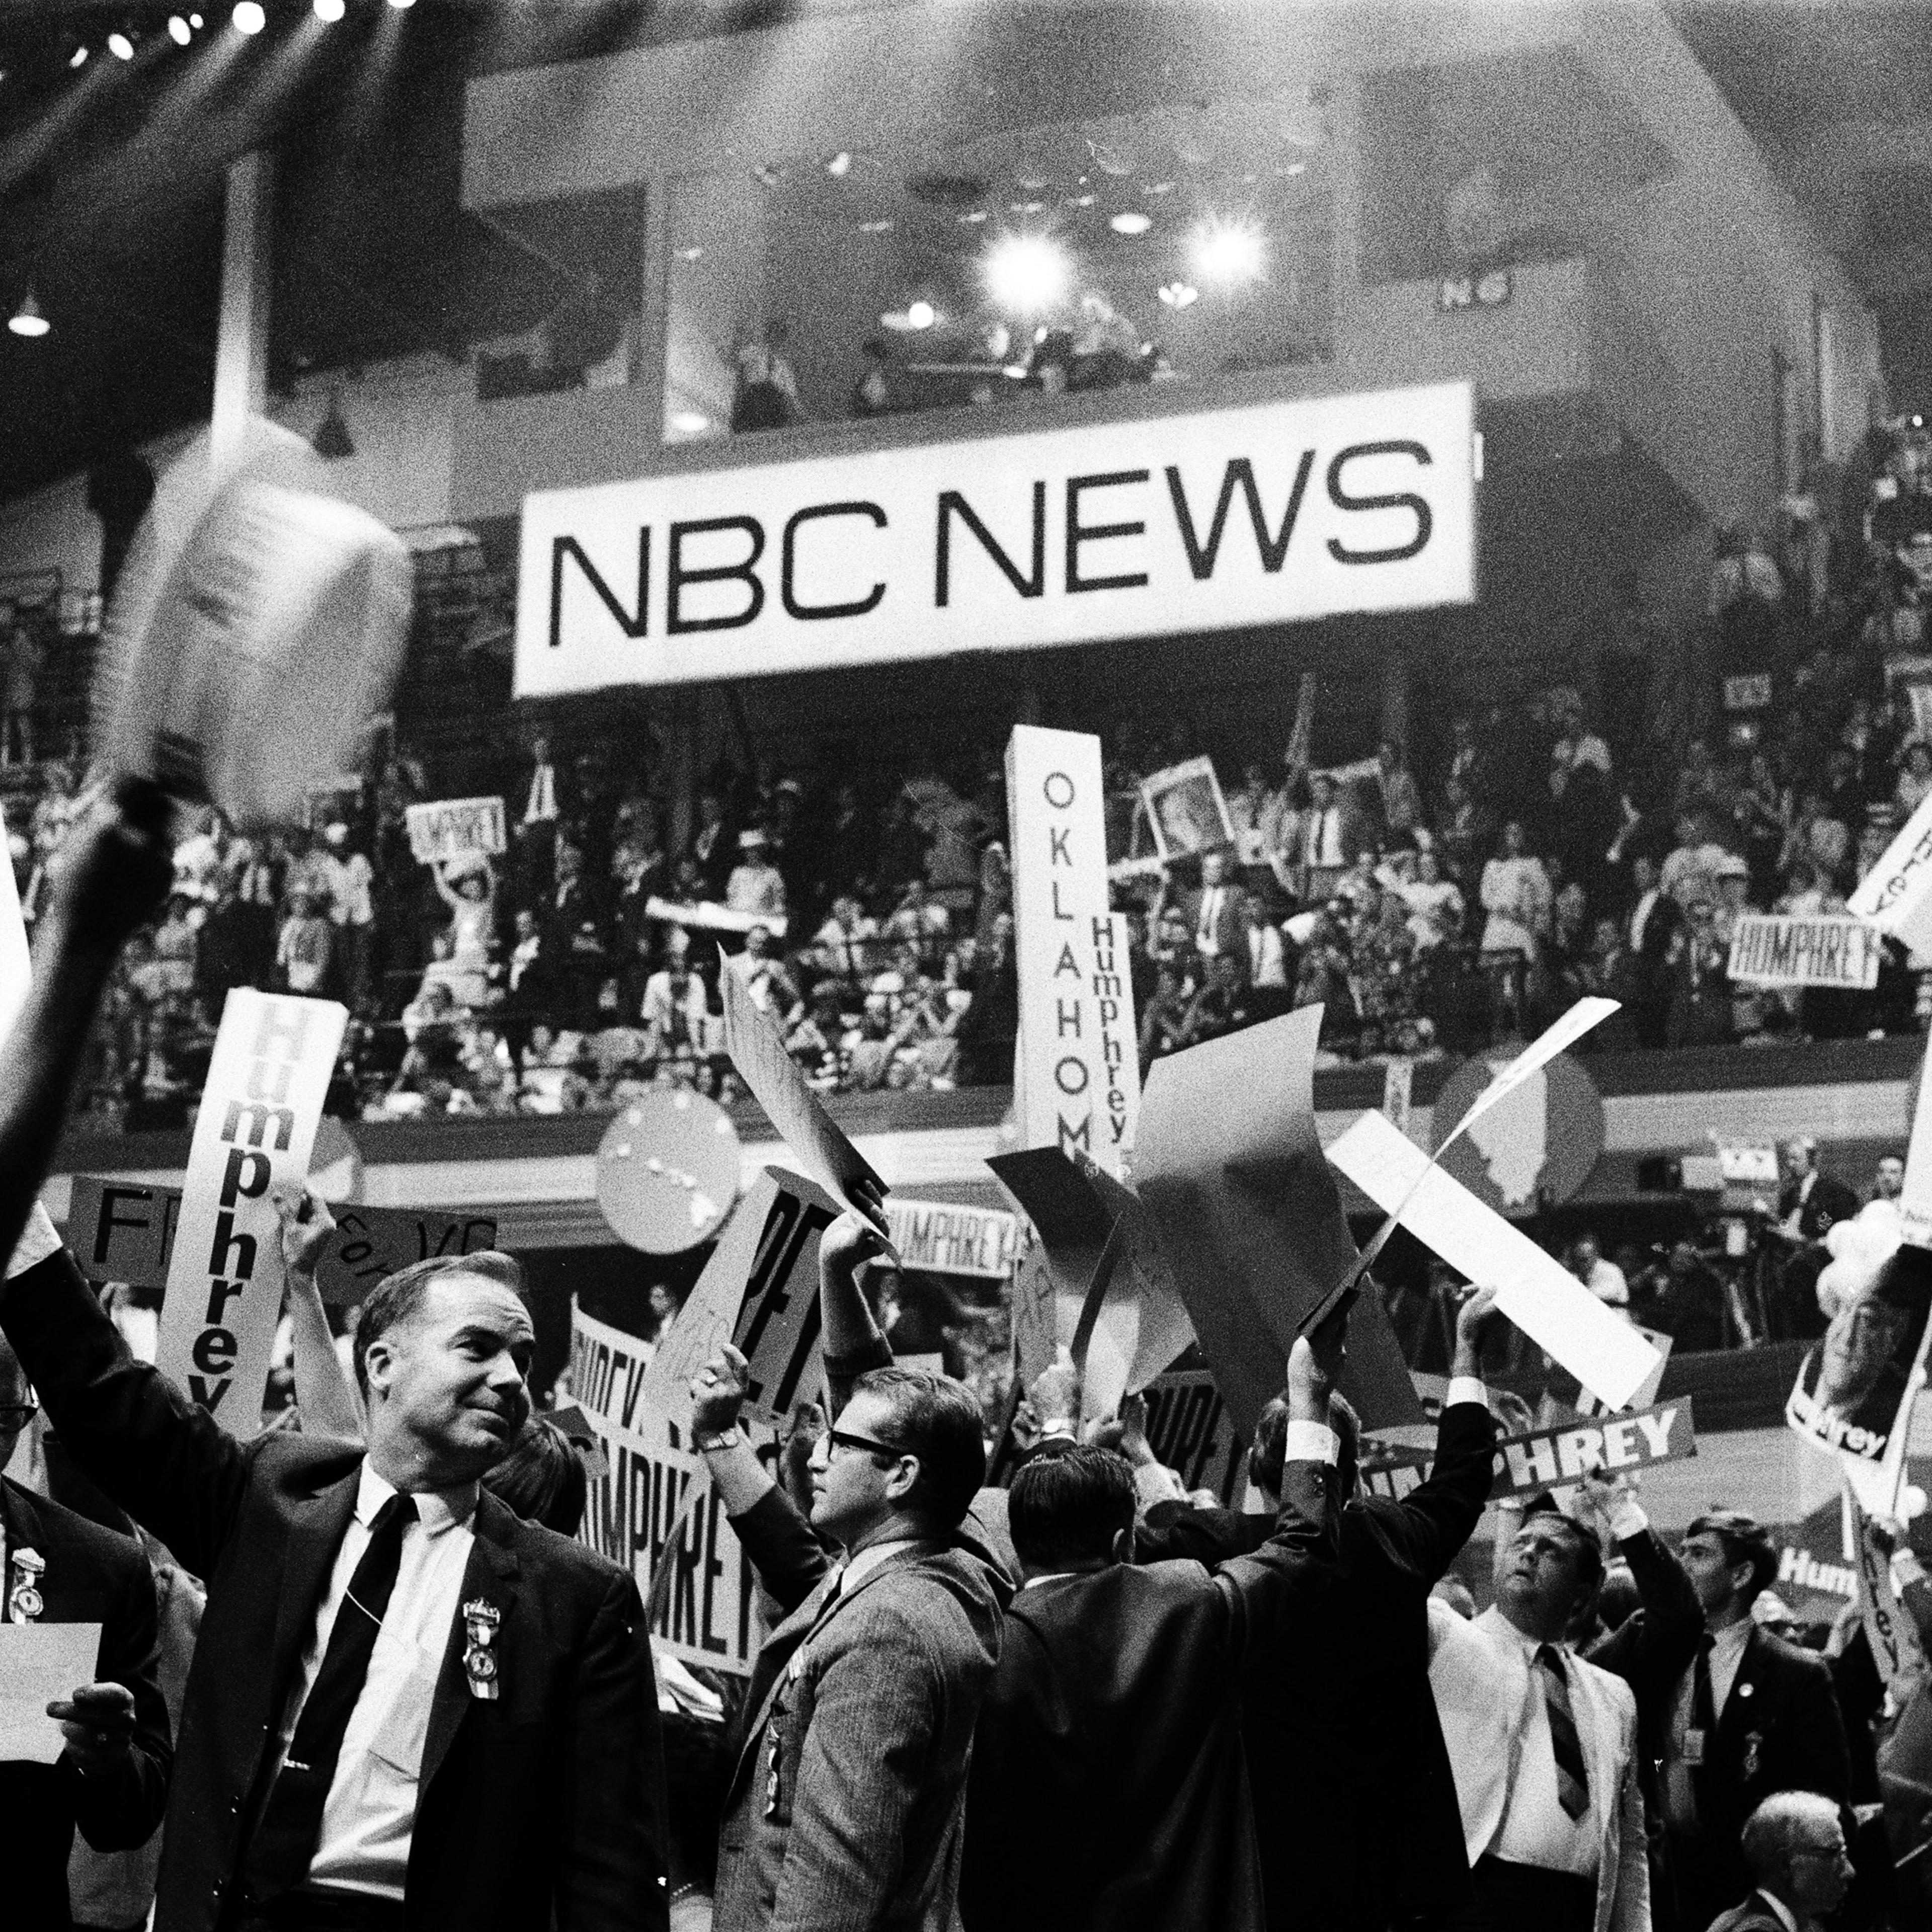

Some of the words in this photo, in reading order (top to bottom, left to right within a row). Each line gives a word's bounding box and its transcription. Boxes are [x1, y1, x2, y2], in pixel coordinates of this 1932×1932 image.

[549, 501, 888, 648] NBC
[934, 439, 1434, 608] NEWS
[1043, 771, 1091, 1152] OKLAHOM
[1092, 916, 1127, 1144] Humphrey
[188, 1001, 312, 1416] Humphrey
